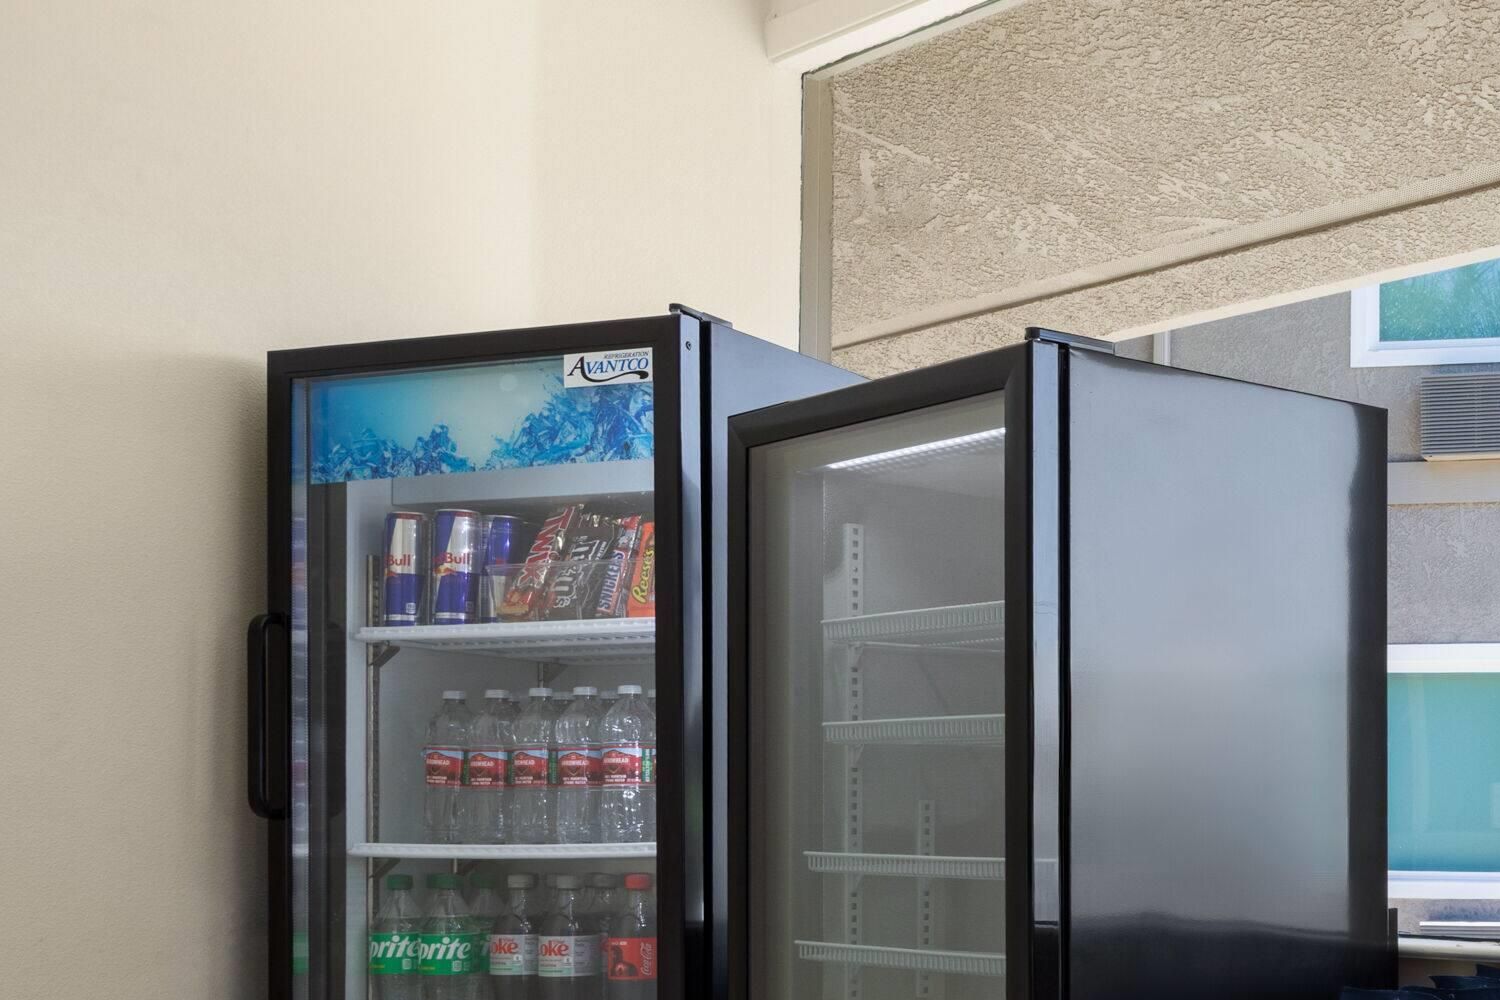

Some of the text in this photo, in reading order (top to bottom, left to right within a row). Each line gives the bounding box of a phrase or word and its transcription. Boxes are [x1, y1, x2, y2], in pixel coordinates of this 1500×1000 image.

[567, 355, 649, 378] AVANTCO
[370, 935, 419, 960] prite
[419, 936, 471, 960] prite
[490, 938, 518, 954] oke
[540, 940, 569, 957] oke
